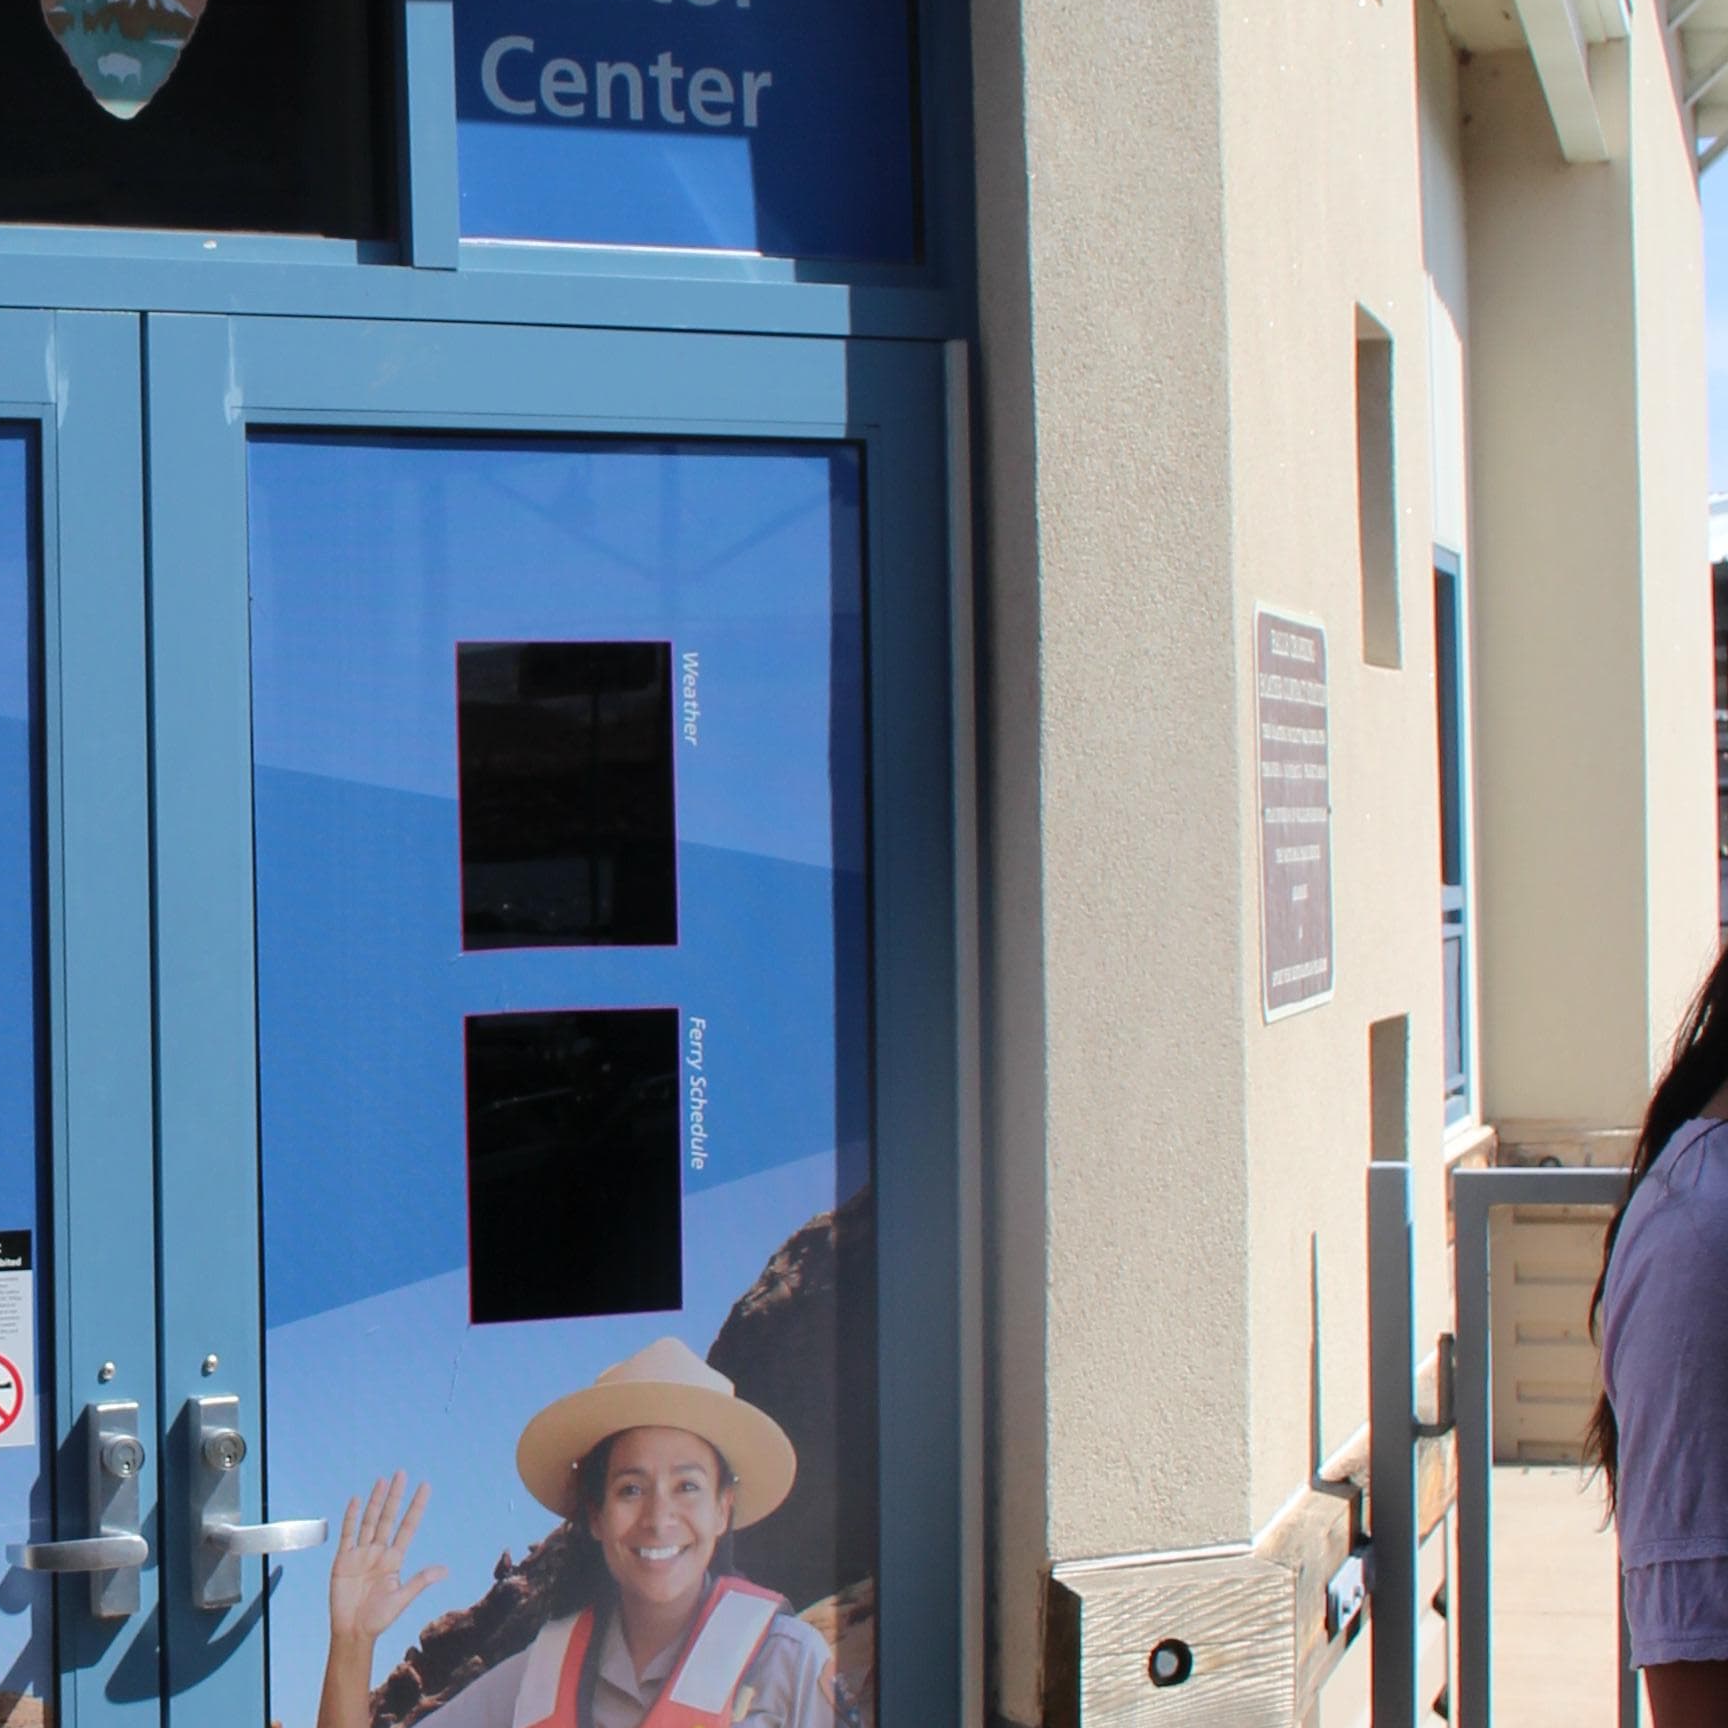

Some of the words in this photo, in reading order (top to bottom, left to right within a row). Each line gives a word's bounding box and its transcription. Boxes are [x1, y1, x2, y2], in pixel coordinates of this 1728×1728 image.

[480, 36, 773, 129] Center
[682, 652, 701, 747] Weather
[686, 1016, 706, 1071] Ferry
[690, 1075, 709, 1171] Schedule
